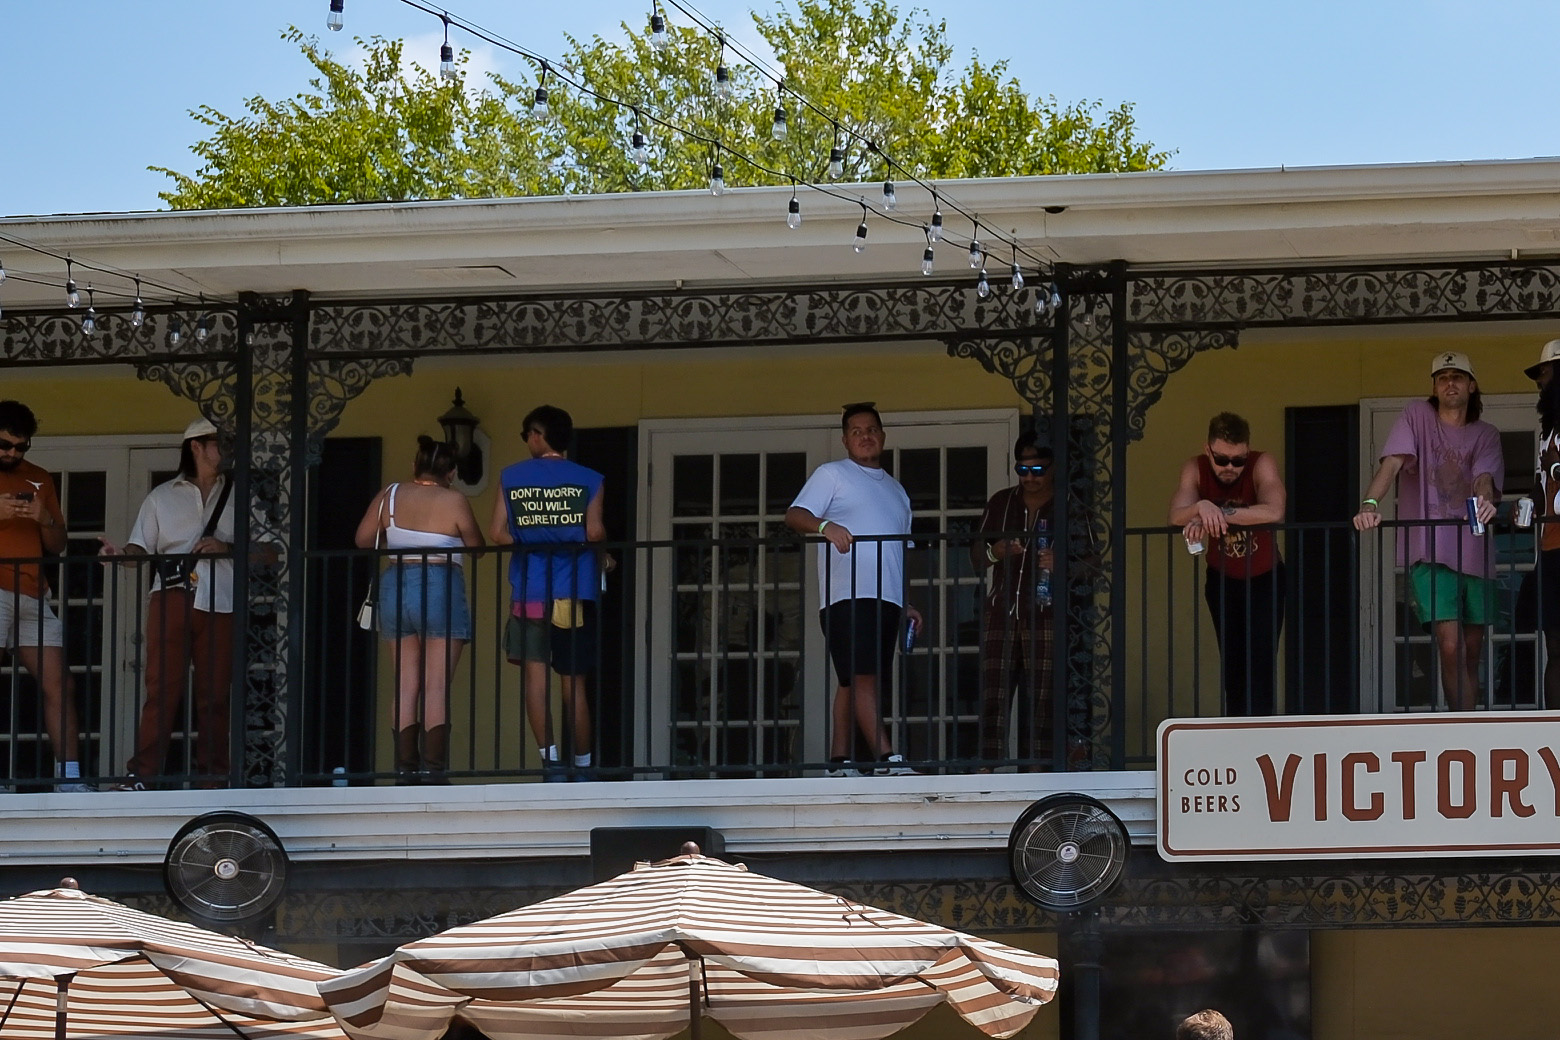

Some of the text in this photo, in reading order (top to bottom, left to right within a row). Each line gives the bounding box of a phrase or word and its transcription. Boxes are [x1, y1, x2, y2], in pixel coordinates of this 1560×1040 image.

[510, 487, 583, 500] DON'T WORRY
[522, 500, 571, 511] YOU WILL
[560, 513, 584, 523] OUT
[1184, 768, 1237, 787] COLD
[1181, 795, 1241, 814] BEERS
